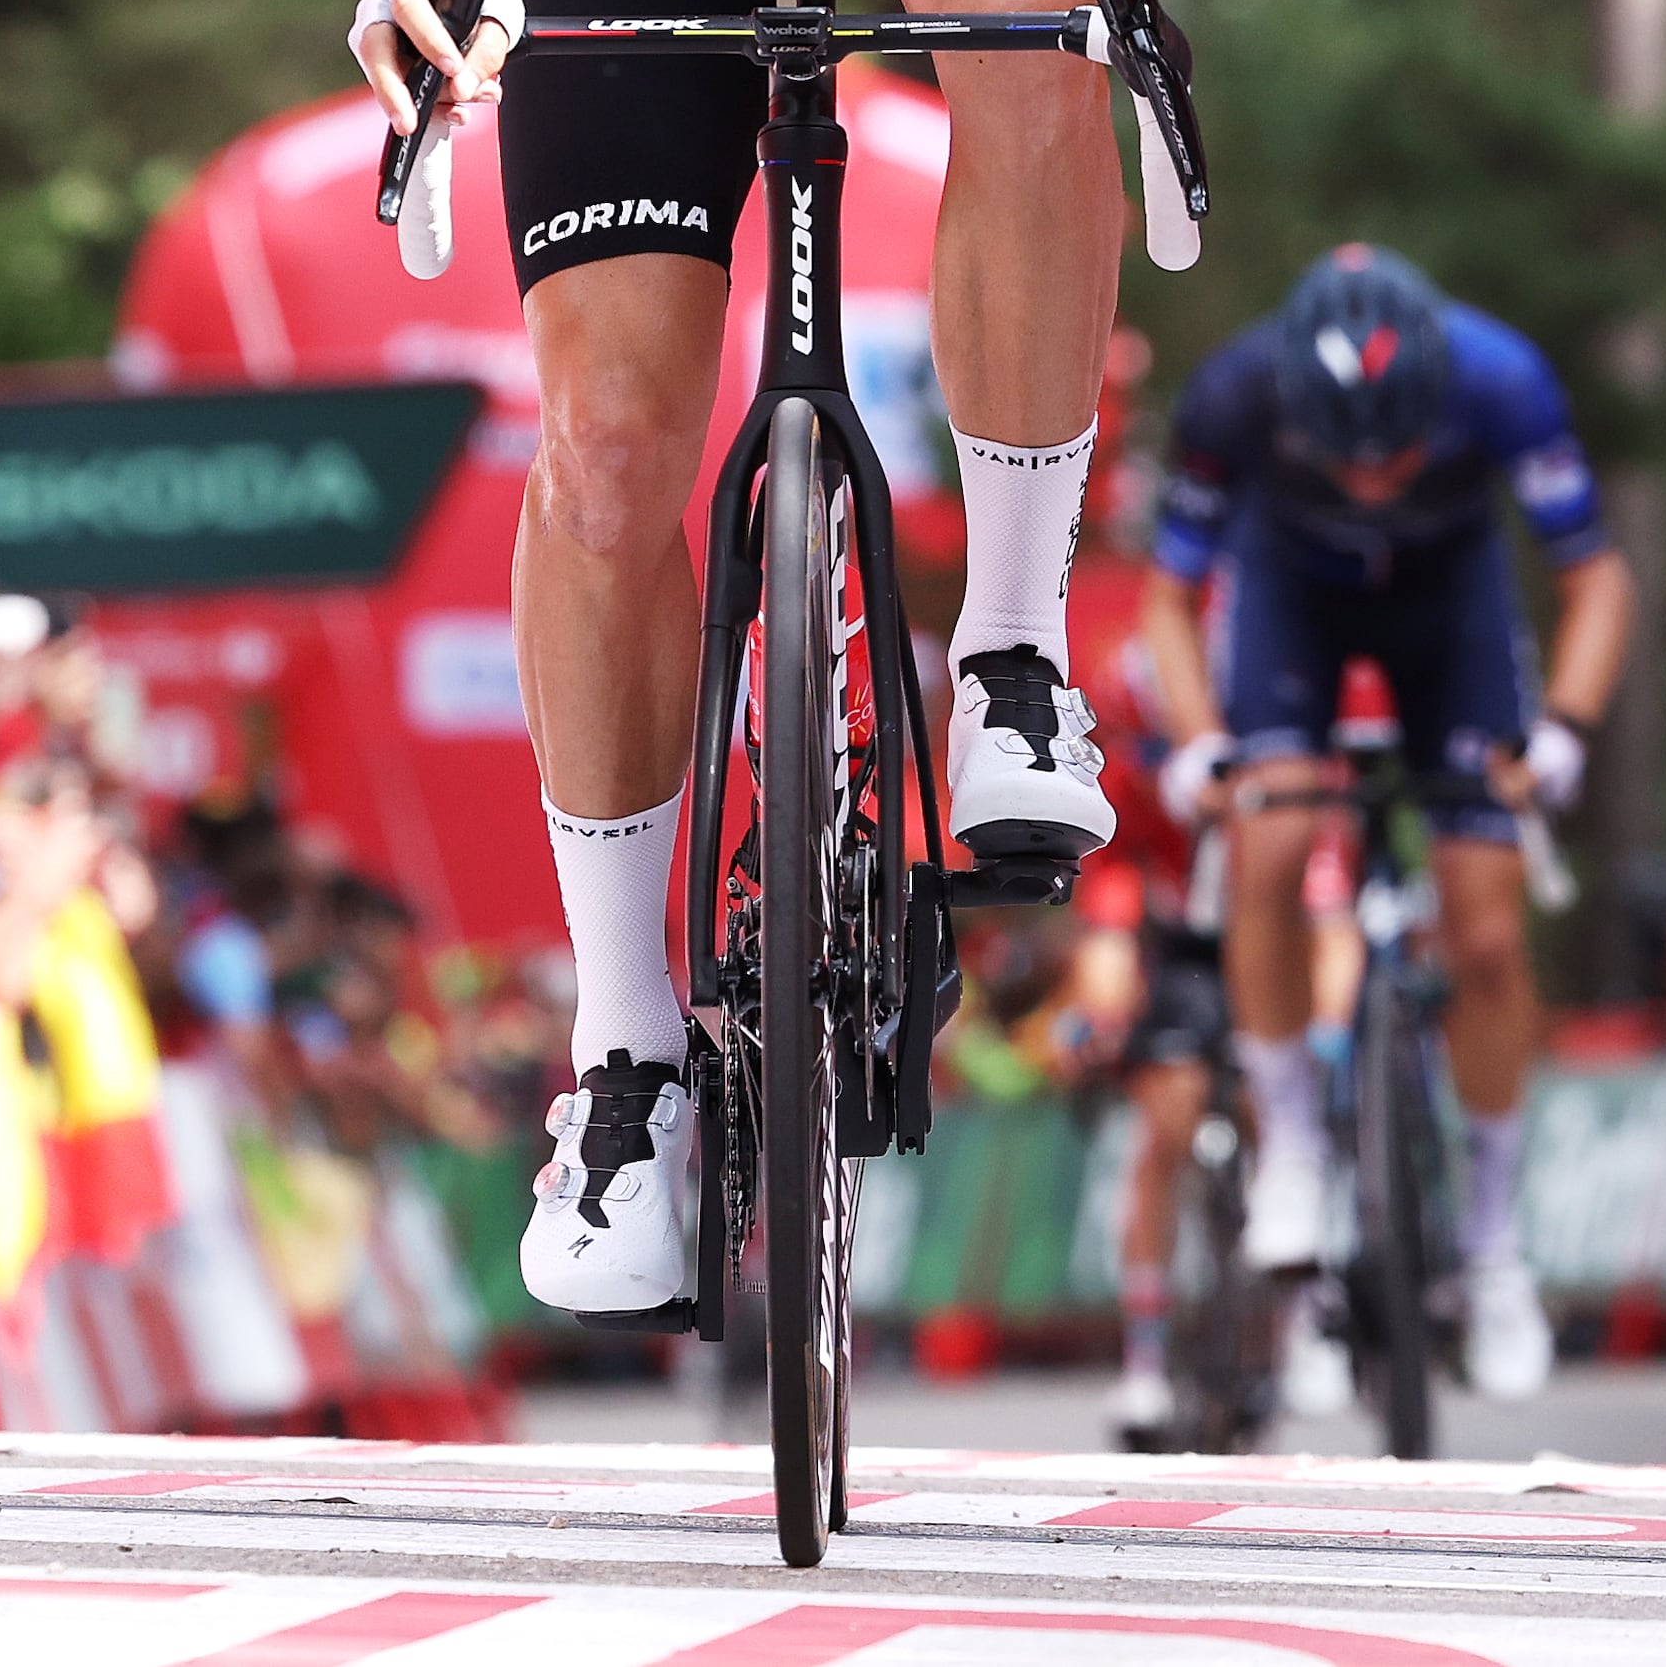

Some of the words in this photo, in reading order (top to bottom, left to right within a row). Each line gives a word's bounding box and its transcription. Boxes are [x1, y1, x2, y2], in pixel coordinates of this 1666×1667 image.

[587, 18, 709, 31] LOOK
[763, 25, 820, 36] wahoo
[523, 198, 708, 257] CORIMA
[791, 175, 814, 356] LOOK
